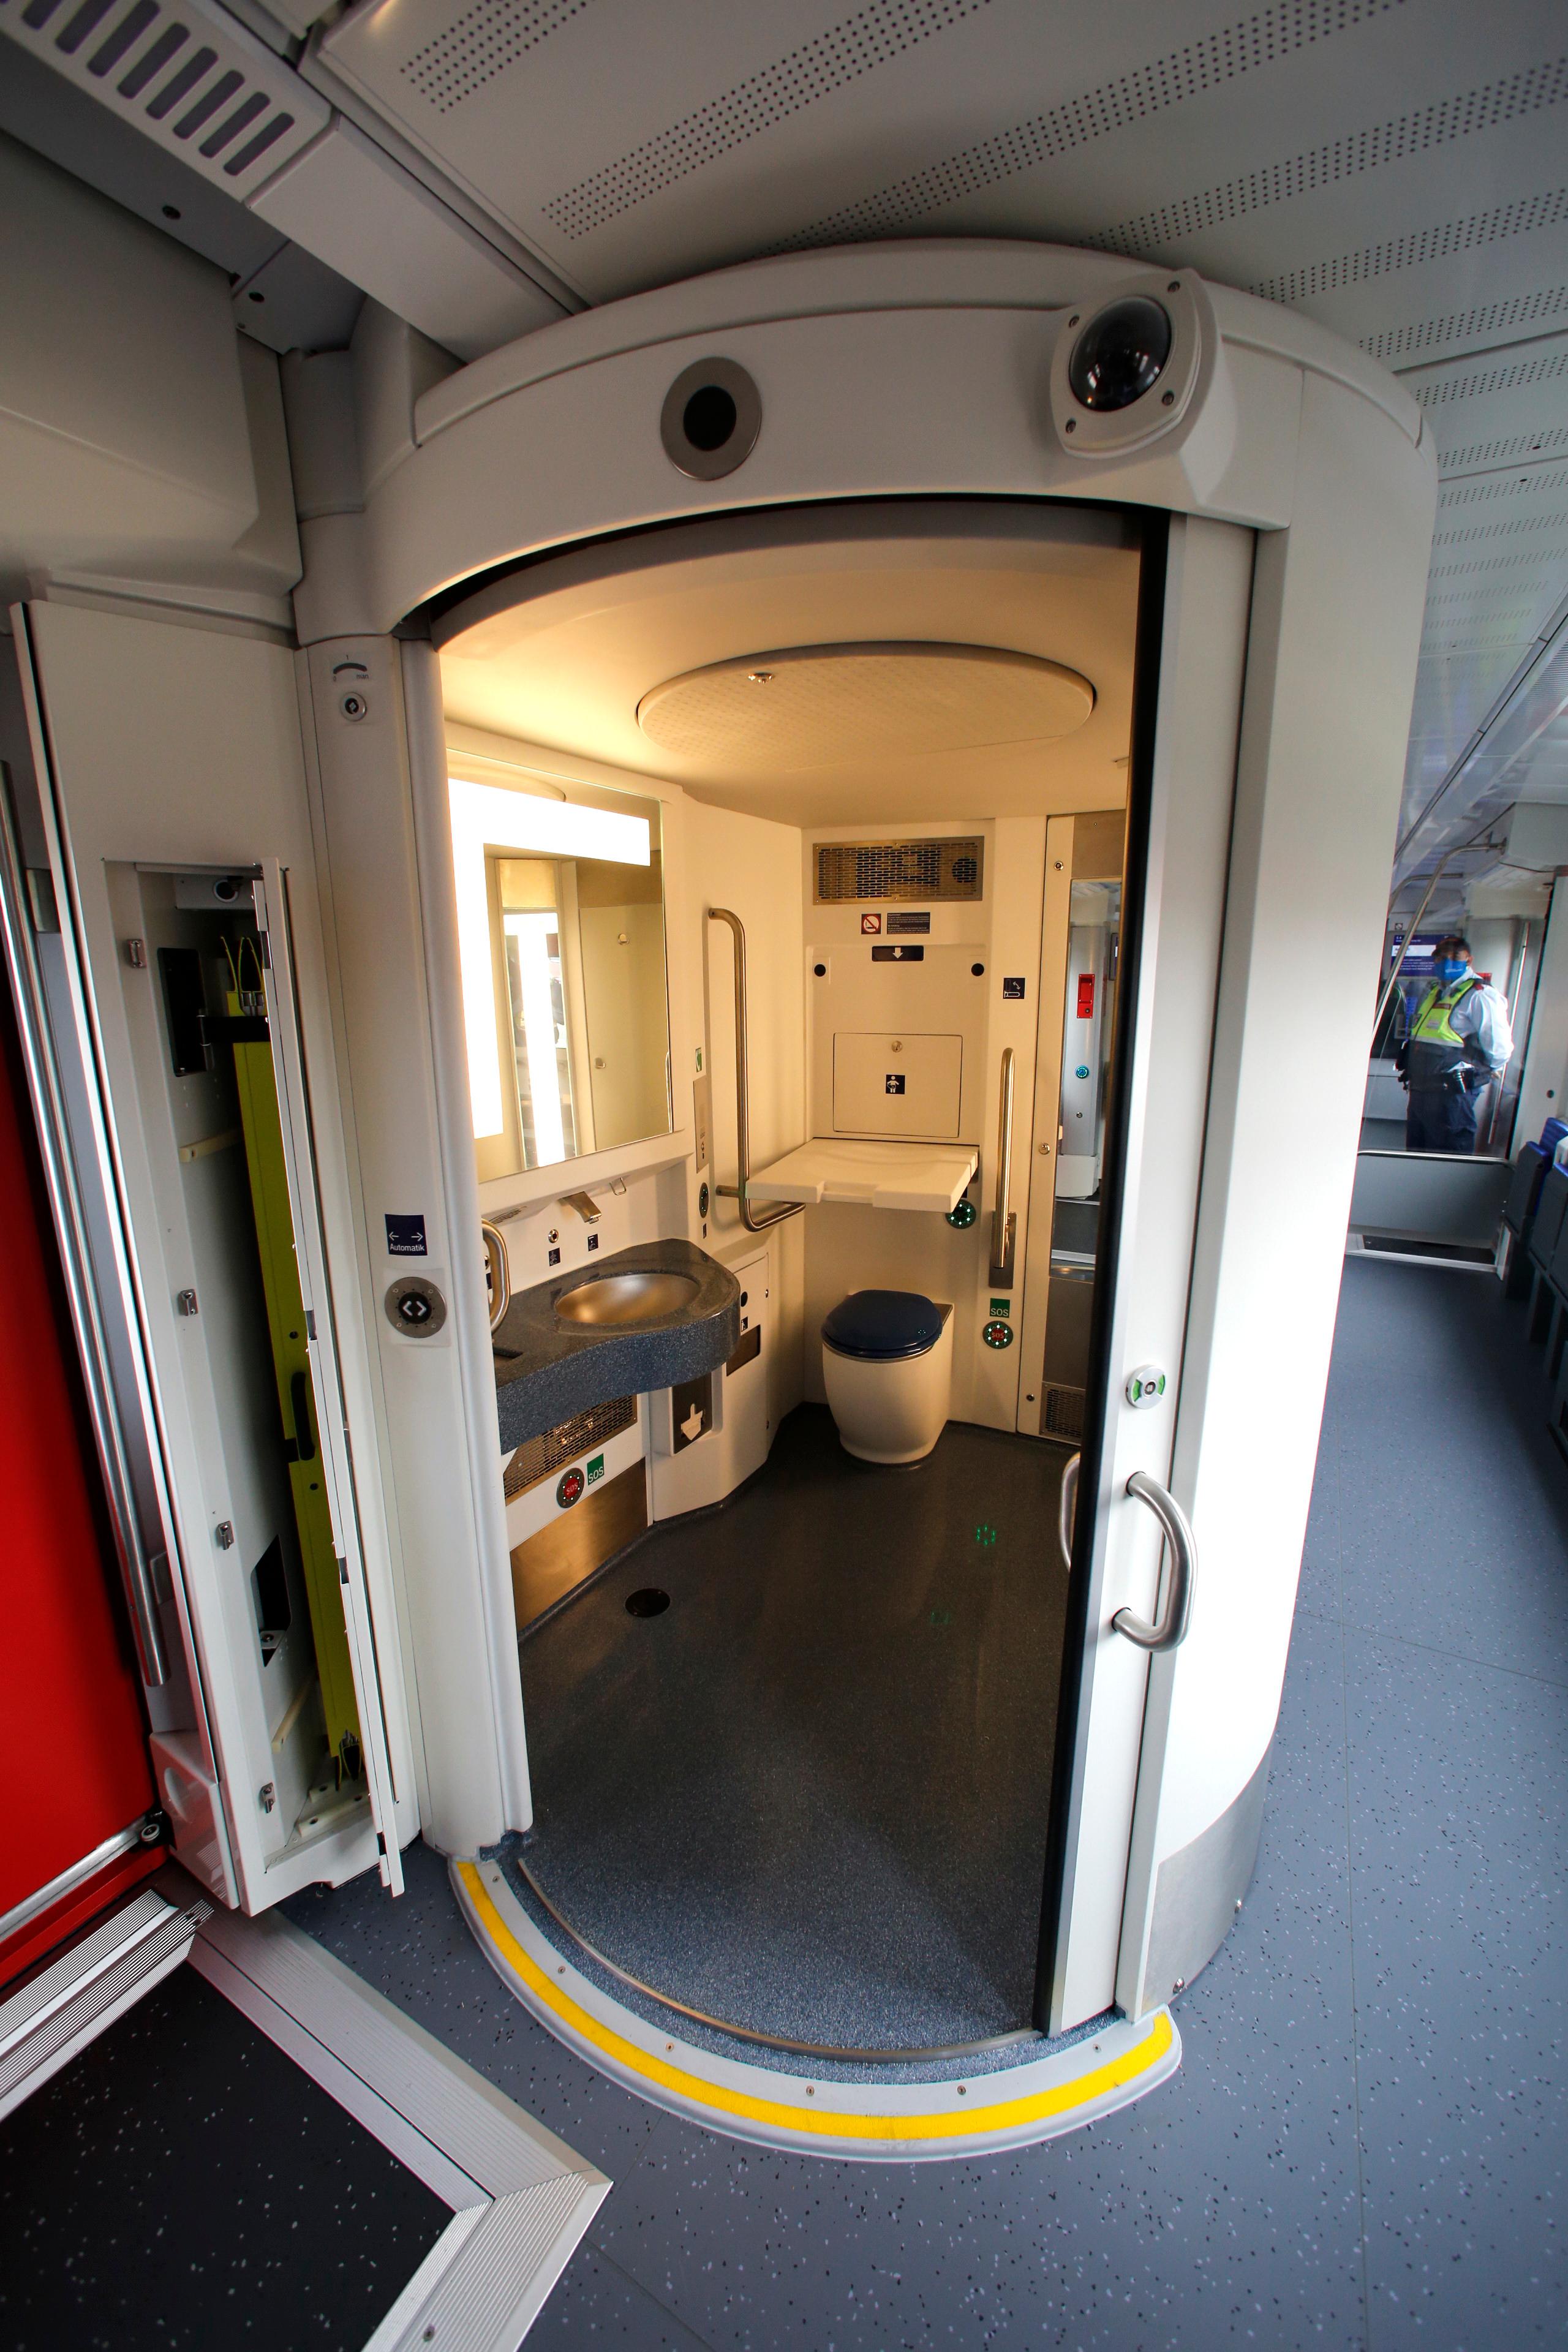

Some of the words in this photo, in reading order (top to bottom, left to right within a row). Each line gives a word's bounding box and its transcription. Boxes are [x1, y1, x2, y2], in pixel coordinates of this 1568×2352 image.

[990, 1308, 1009, 1317] SOS
[588, 1466, 604, 1483] SOS
[566, 1482, 579, 1495] SOS
